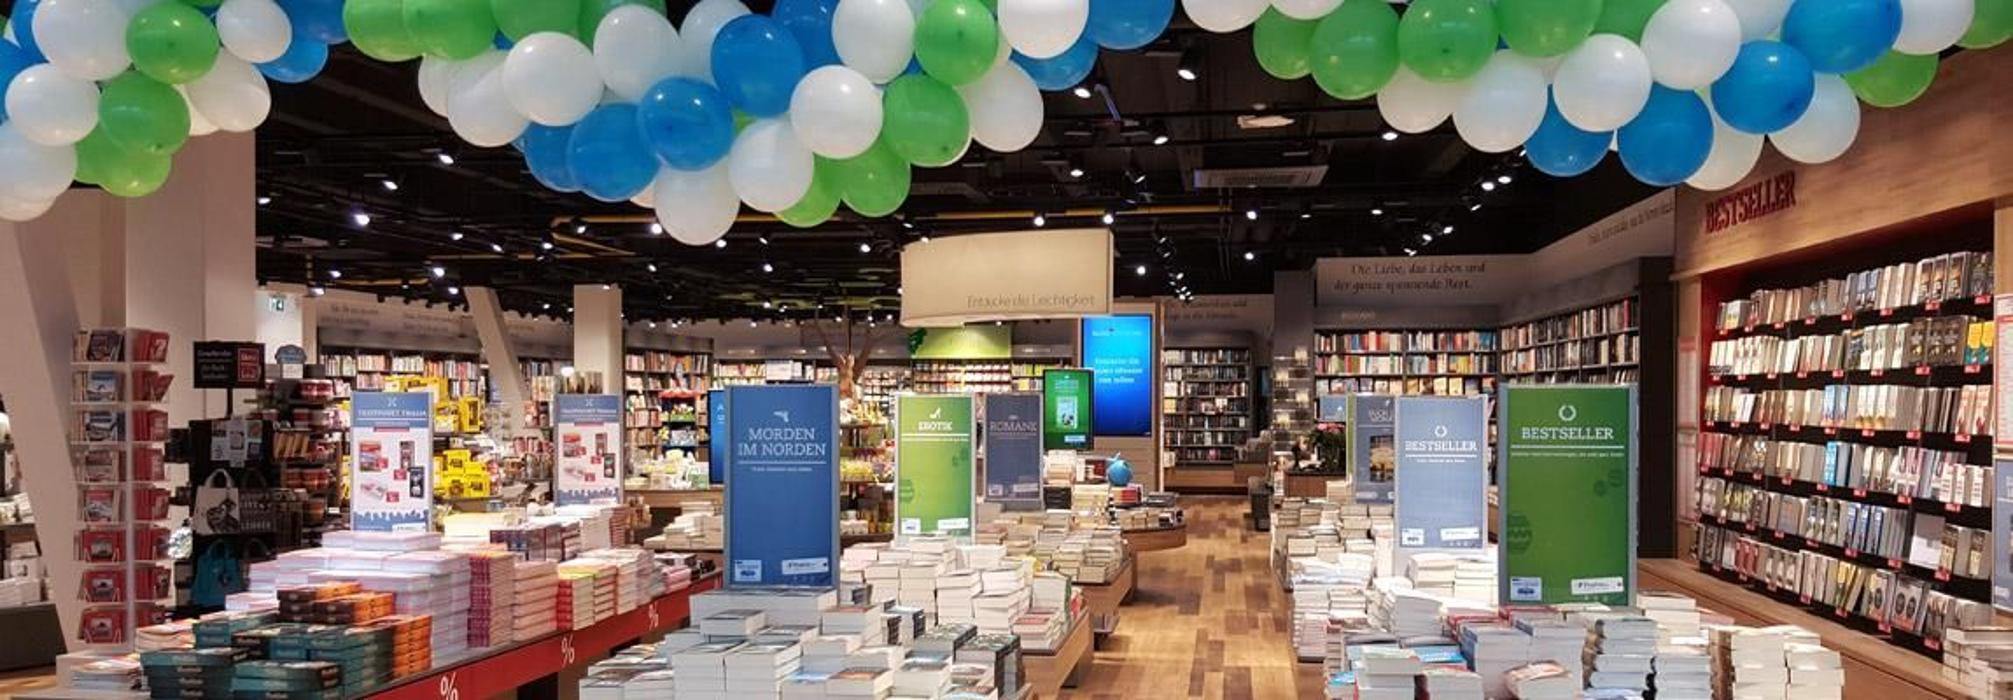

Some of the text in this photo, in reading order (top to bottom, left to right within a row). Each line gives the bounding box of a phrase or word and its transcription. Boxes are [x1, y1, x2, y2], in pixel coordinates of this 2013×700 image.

[1705, 170, 1797, 234] BESTSELLER
[1352, 263, 1369, 274] Die
[1409, 263, 1427, 274] das
[1431, 263, 1463, 274] Leben
[1465, 262, 1485, 273] und
[918, 421, 953, 431] EROTIK
[1521, 426, 1615, 440] BESTSELLER
[748, 427, 815, 441] MORDEN
[737, 443, 827, 456] IM NORDEN
[1404, 440, 1478, 451] BESTSELLER
[560, 634, 576, 668] %
[440, 671, 459, 700] %
